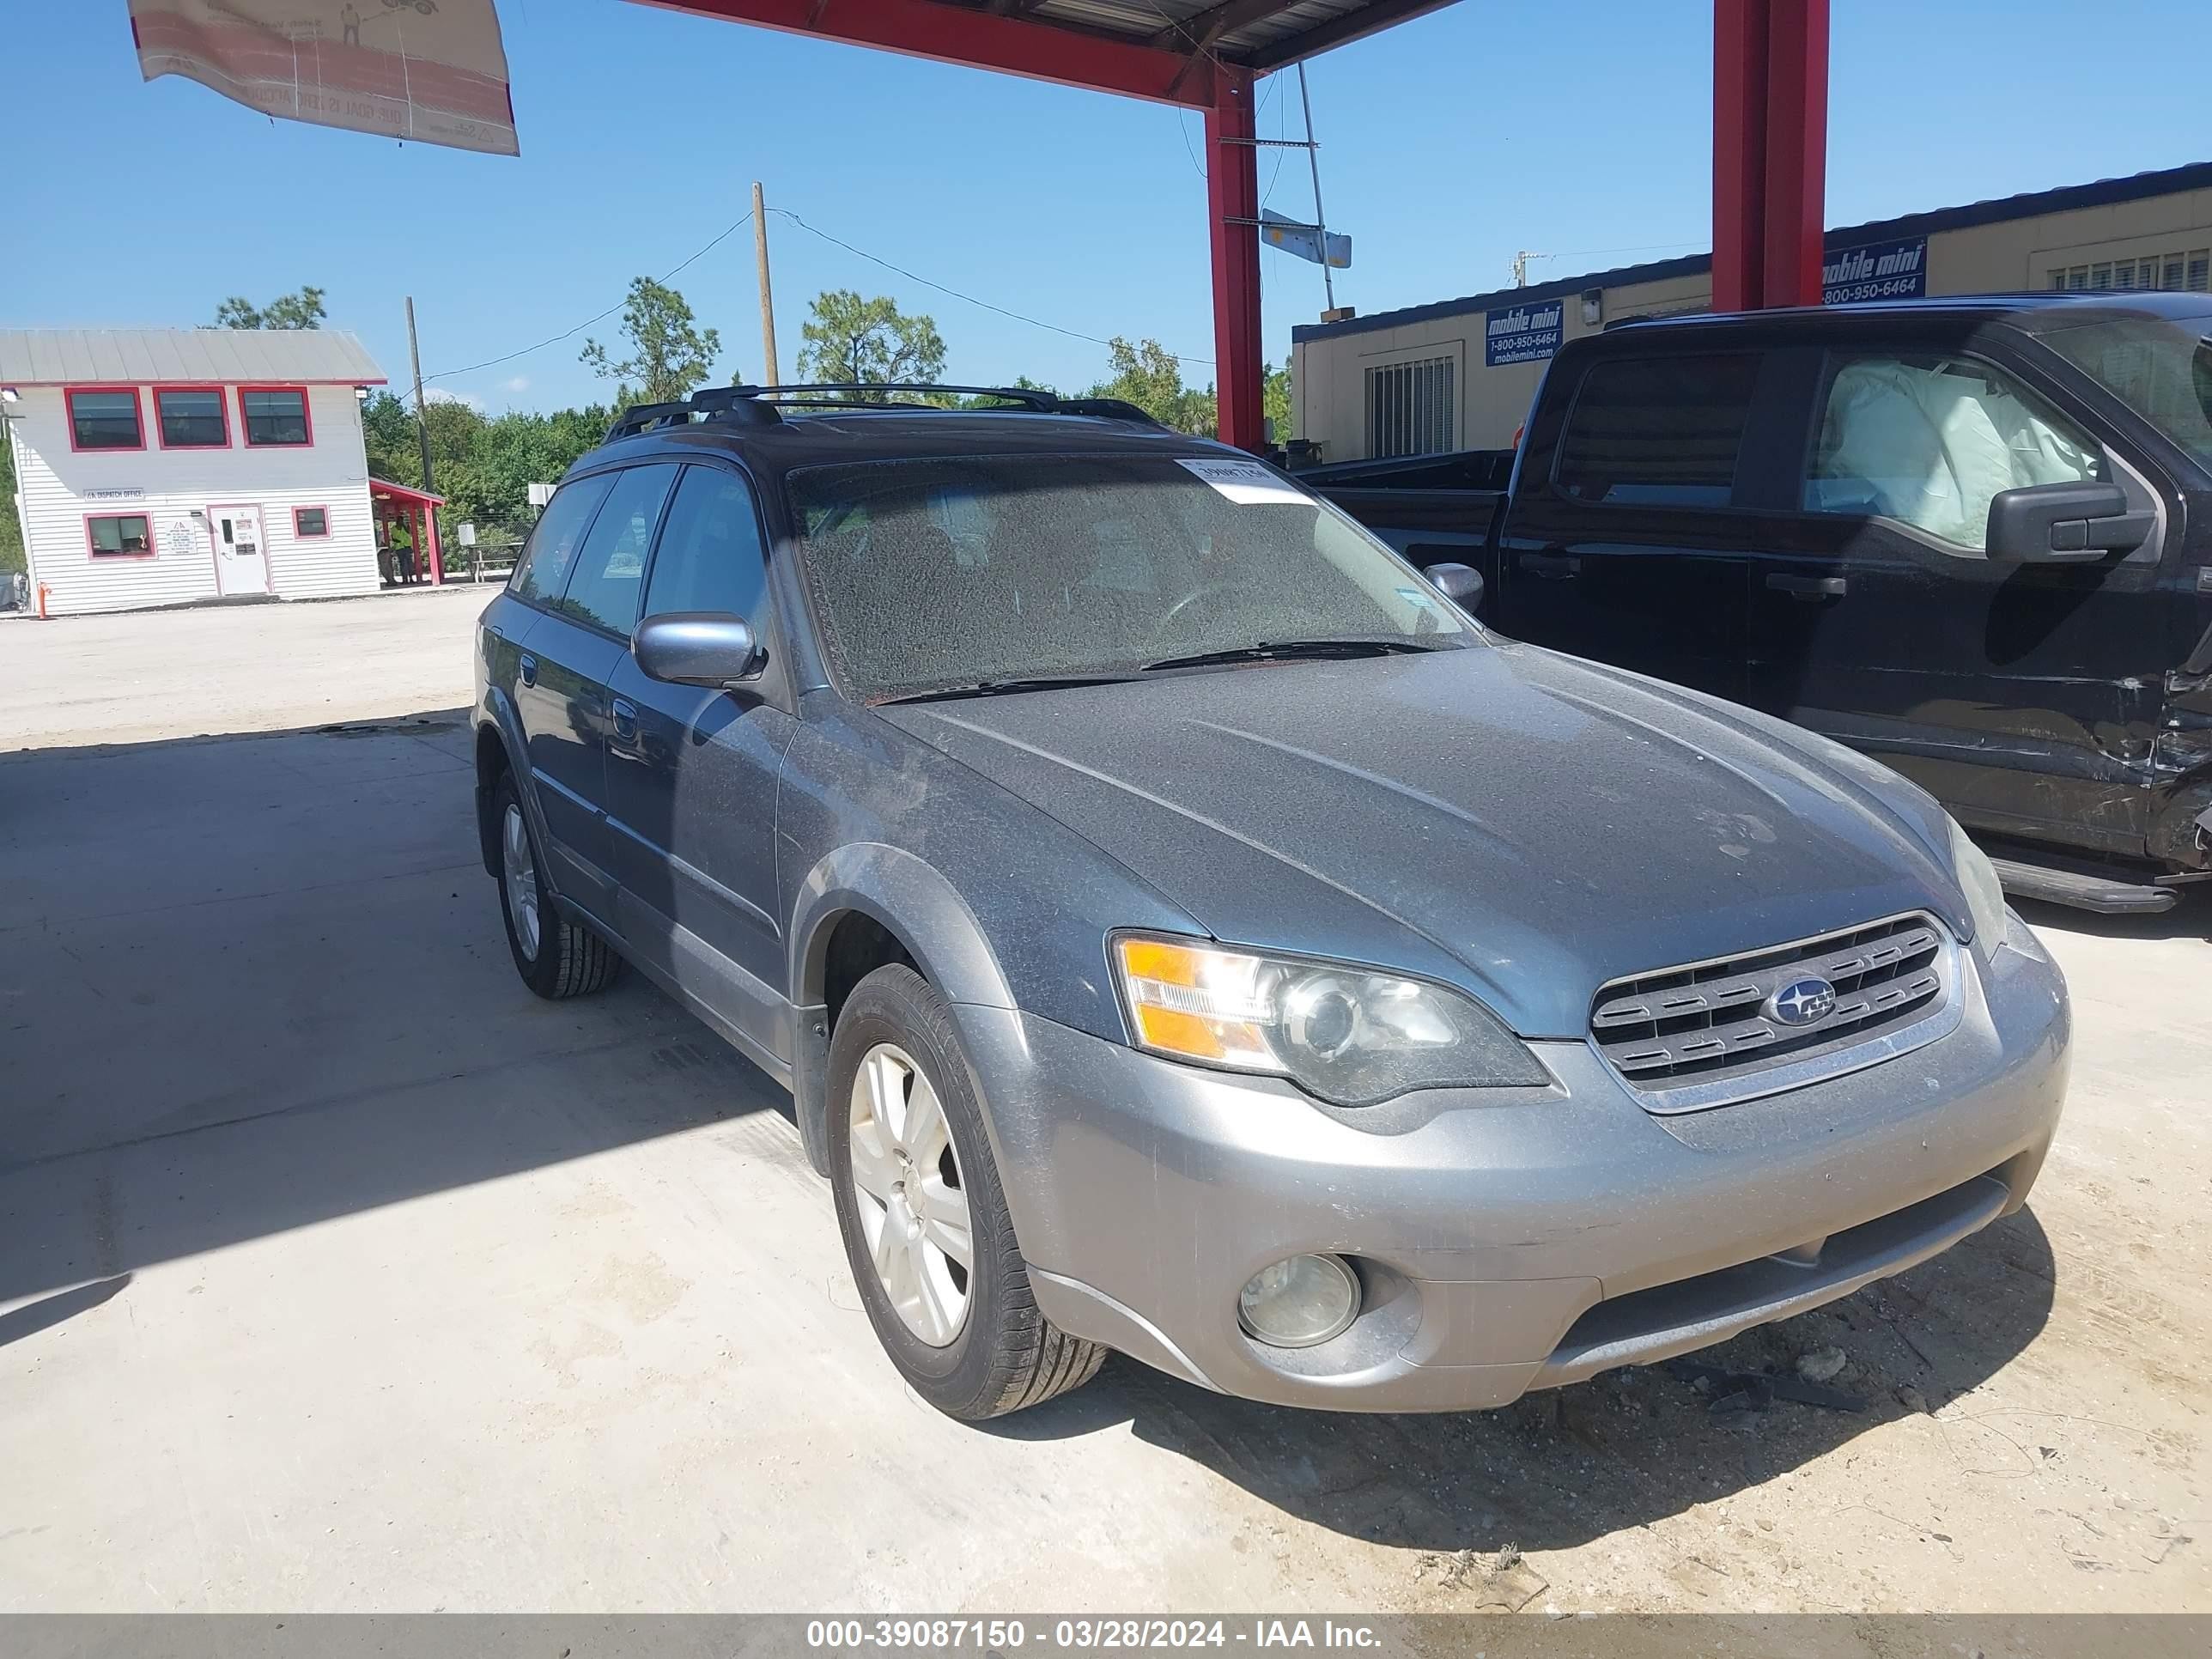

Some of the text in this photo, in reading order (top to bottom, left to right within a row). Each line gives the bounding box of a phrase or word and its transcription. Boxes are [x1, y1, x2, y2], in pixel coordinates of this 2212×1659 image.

[1875, 244, 1921, 276] mini
[1821, 278, 1917, 305] -800-950-6464
[1488, 306, 1560, 336] mobile mini
[1491, 331, 1558, 352] 1-800-950-6464
[1494, 348, 1553, 364] mobilemini.com
